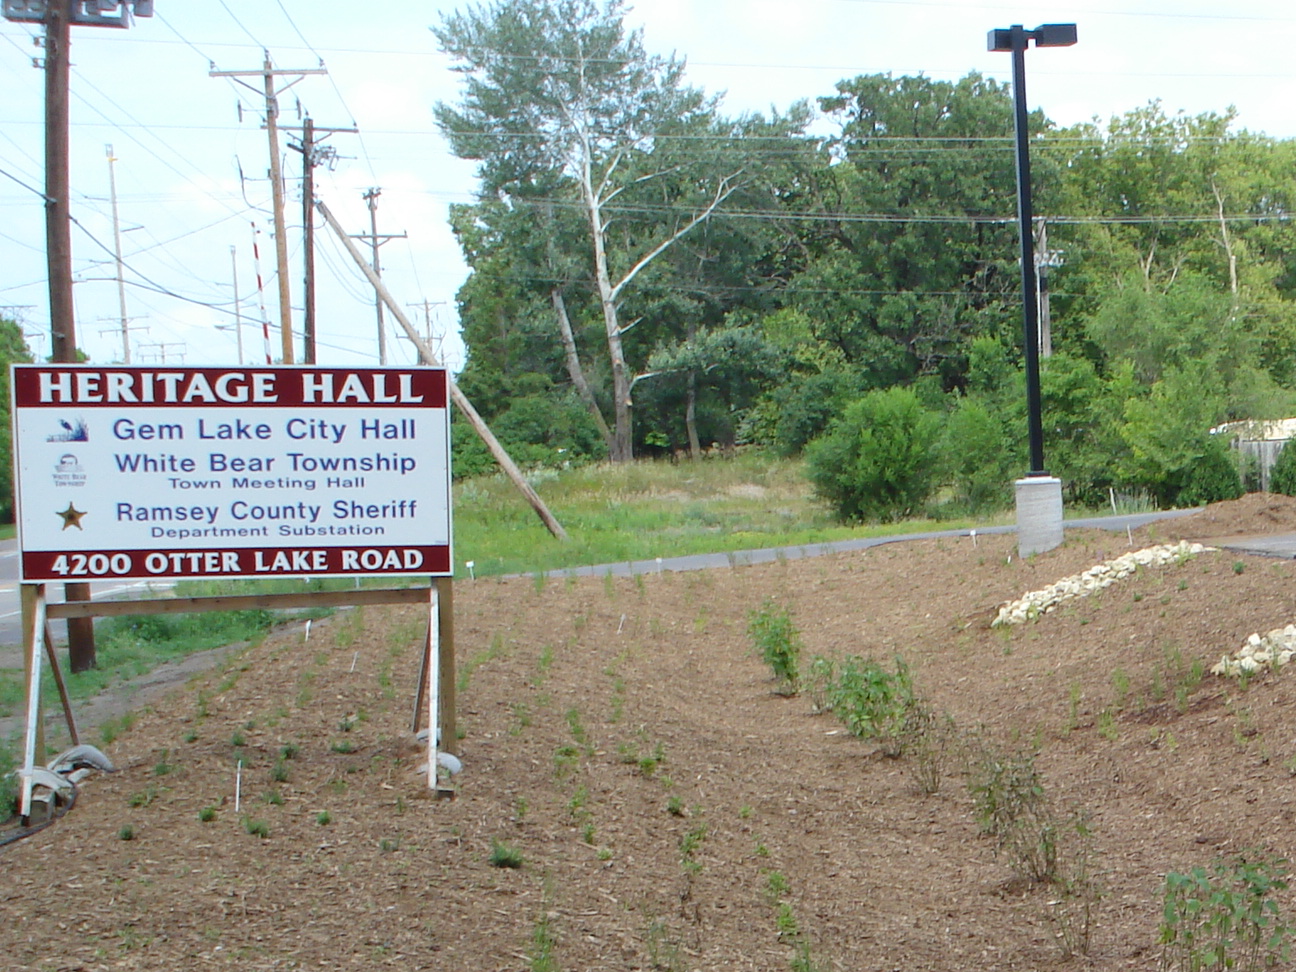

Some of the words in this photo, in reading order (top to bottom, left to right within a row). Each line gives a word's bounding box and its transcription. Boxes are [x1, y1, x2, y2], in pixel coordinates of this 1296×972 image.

[39, 373, 278, 402] HERITAGE
[302, 374, 424, 402] HALL
[113, 419, 183, 440] Gem
[199, 419, 271, 439] Lake
[287, 419, 346, 443] City
[362, 419, 415, 439] Hall
[115, 454, 195, 472] White
[210, 454, 275, 472] Bear
[287, 453, 416, 475] Township
[168, 478, 221, 489] Town
[233, 478, 315, 490] Meeting
[327, 477, 364, 487] Hall
[117, 503, 218, 524] Ramsey
[231, 501, 320, 523] County
[334, 500, 416, 519] Sheriff
[152, 526, 268, 539] Department
[279, 525, 384, 536] Substation
[52, 554, 132, 576] 4200
[145, 552, 241, 574] OTTER
[254, 551, 328, 572] LAKE
[342, 550, 424, 570] ROAD
